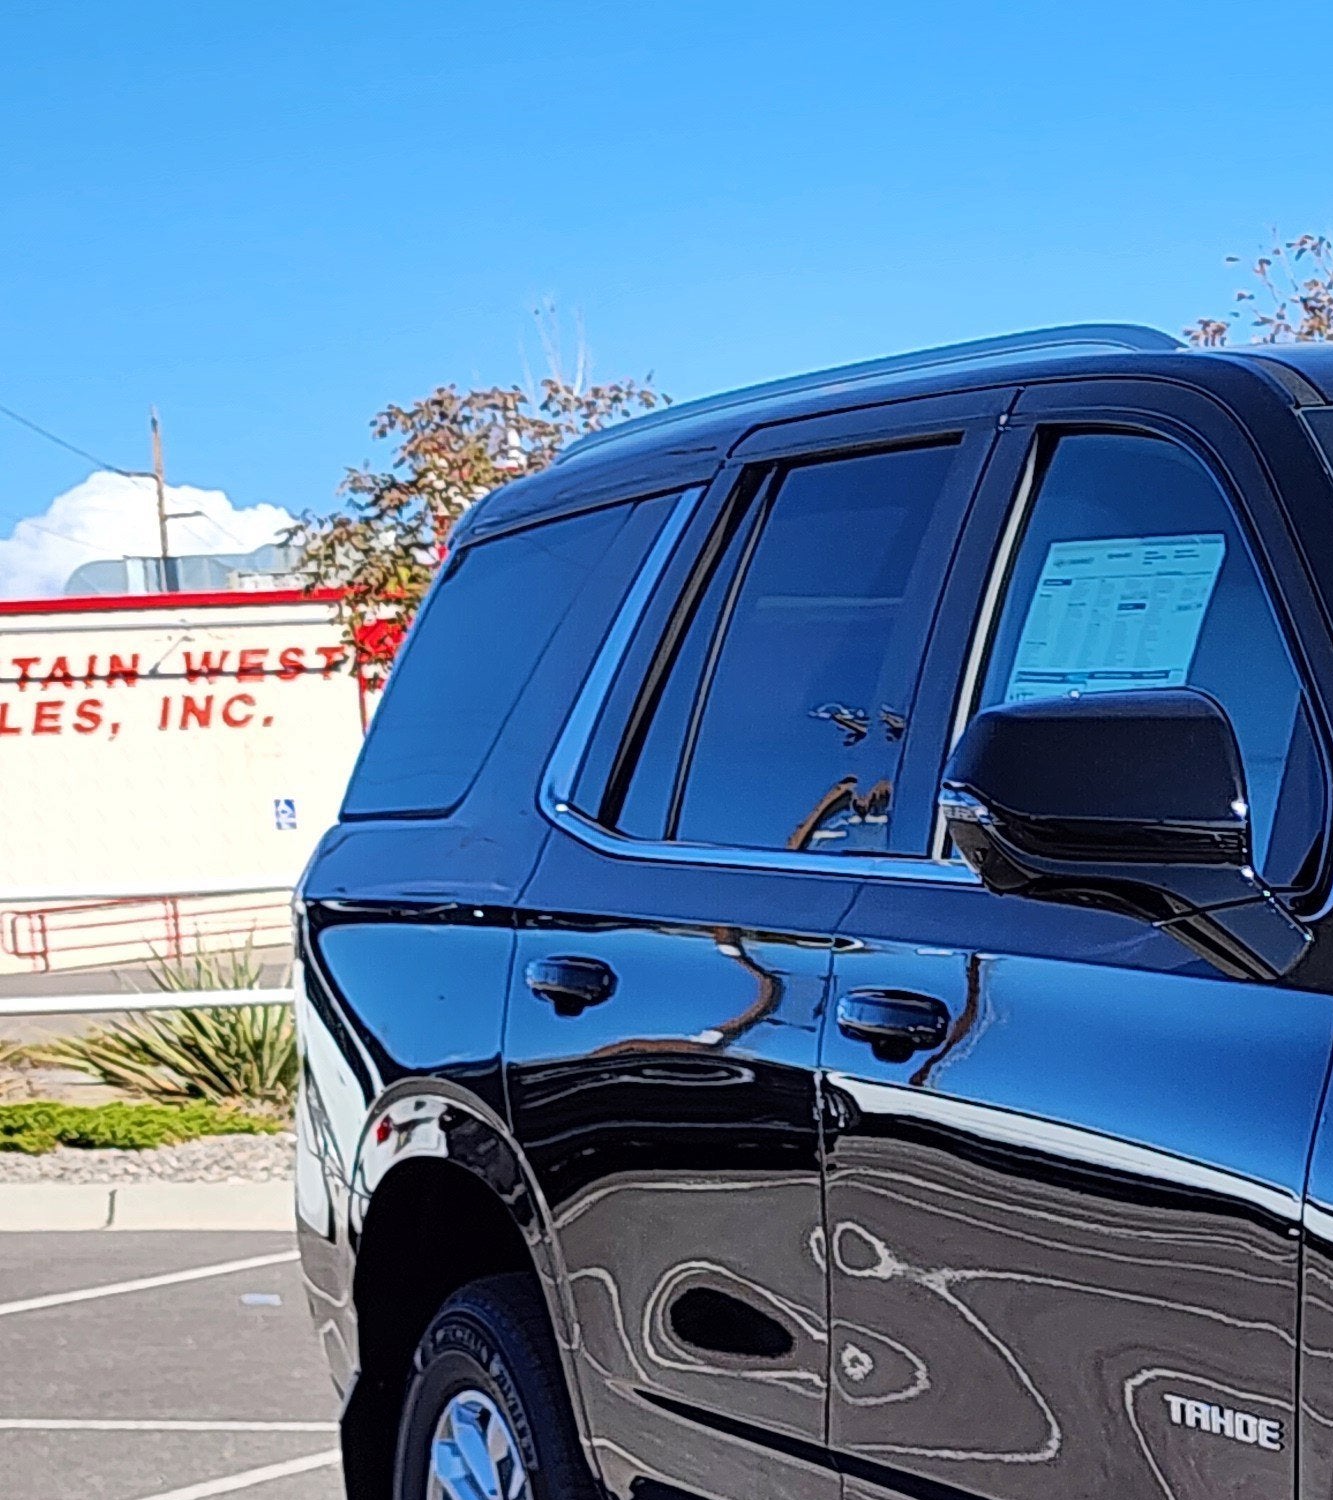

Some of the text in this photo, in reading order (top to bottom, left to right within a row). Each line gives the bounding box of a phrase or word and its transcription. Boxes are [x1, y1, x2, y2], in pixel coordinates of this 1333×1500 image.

[12, 653, 140, 691] TAIN
[158, 692, 274, 731] INC.
[1163, 1393, 1284, 1451] TAHOE
